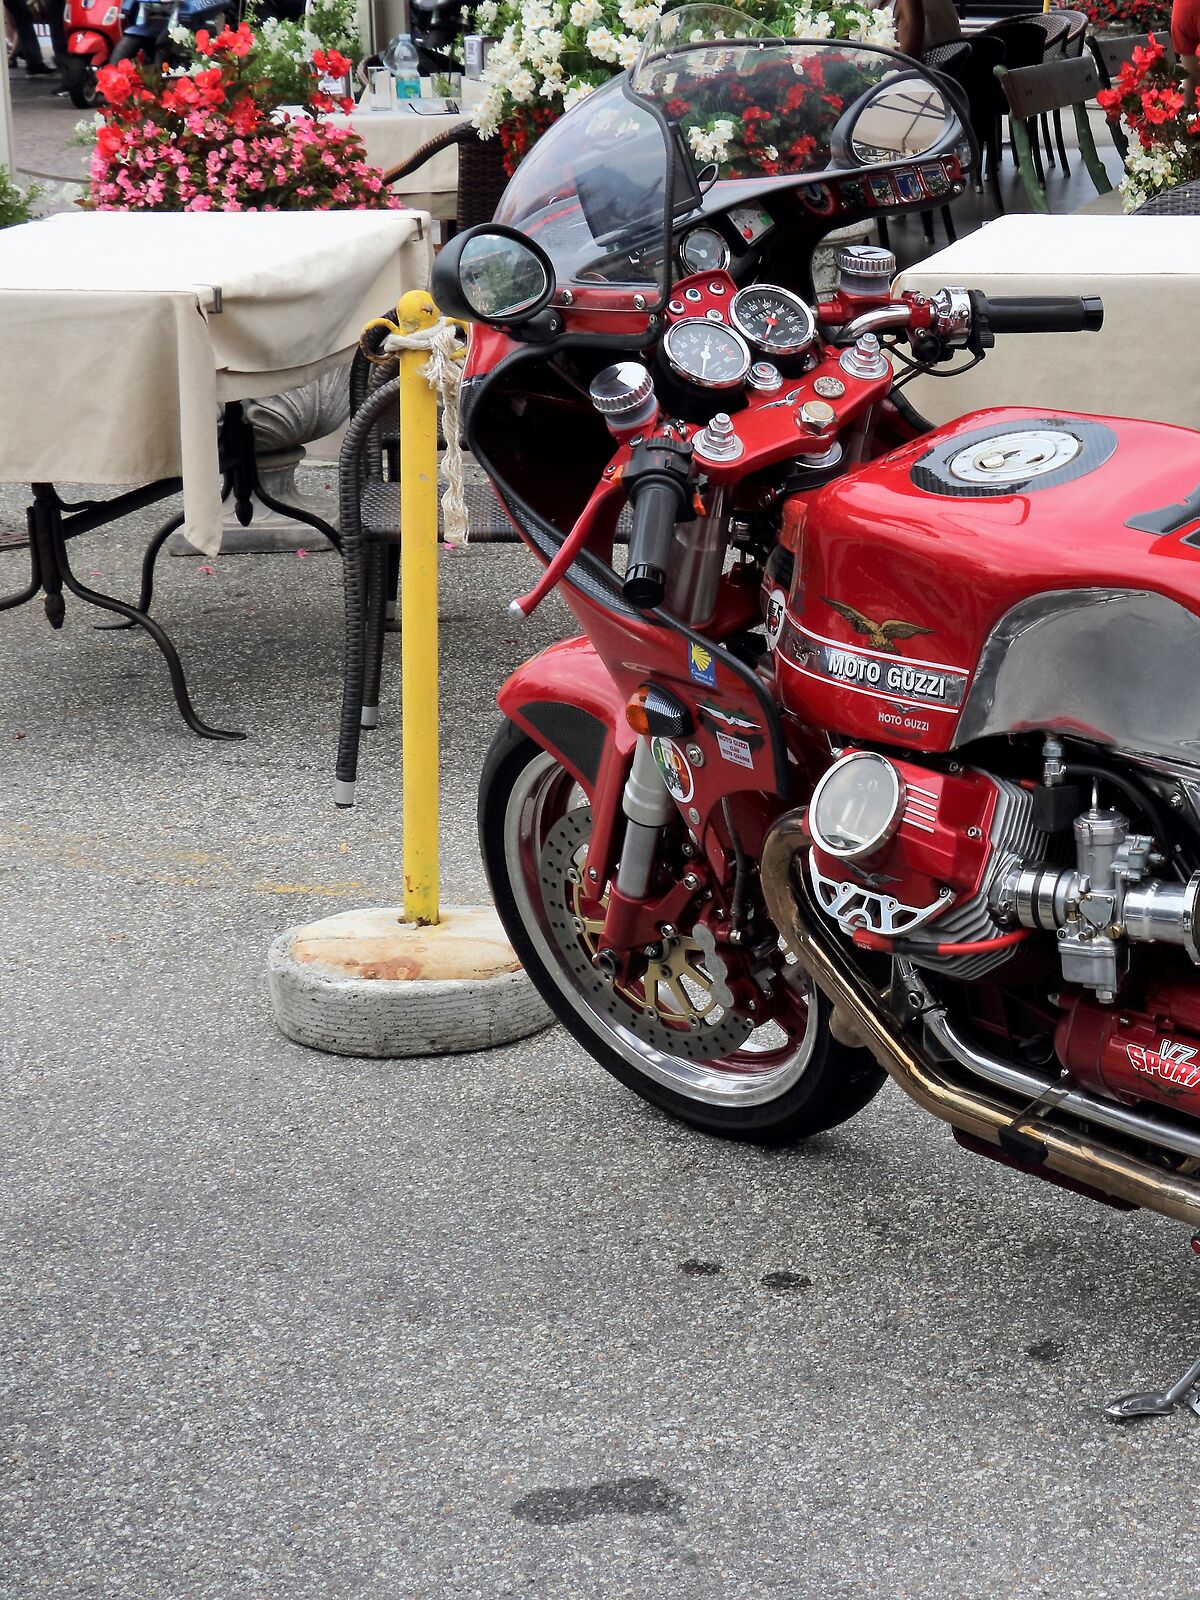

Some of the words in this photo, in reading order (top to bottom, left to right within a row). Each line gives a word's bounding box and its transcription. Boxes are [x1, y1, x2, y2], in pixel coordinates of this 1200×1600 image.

[828, 652, 881, 683] MOTO
[887, 666, 946, 699] GUZZI
[878, 712, 902, 726] MOTO
[904, 718, 929, 731] GUZZI
[1160, 1038, 1199, 1065] V7
